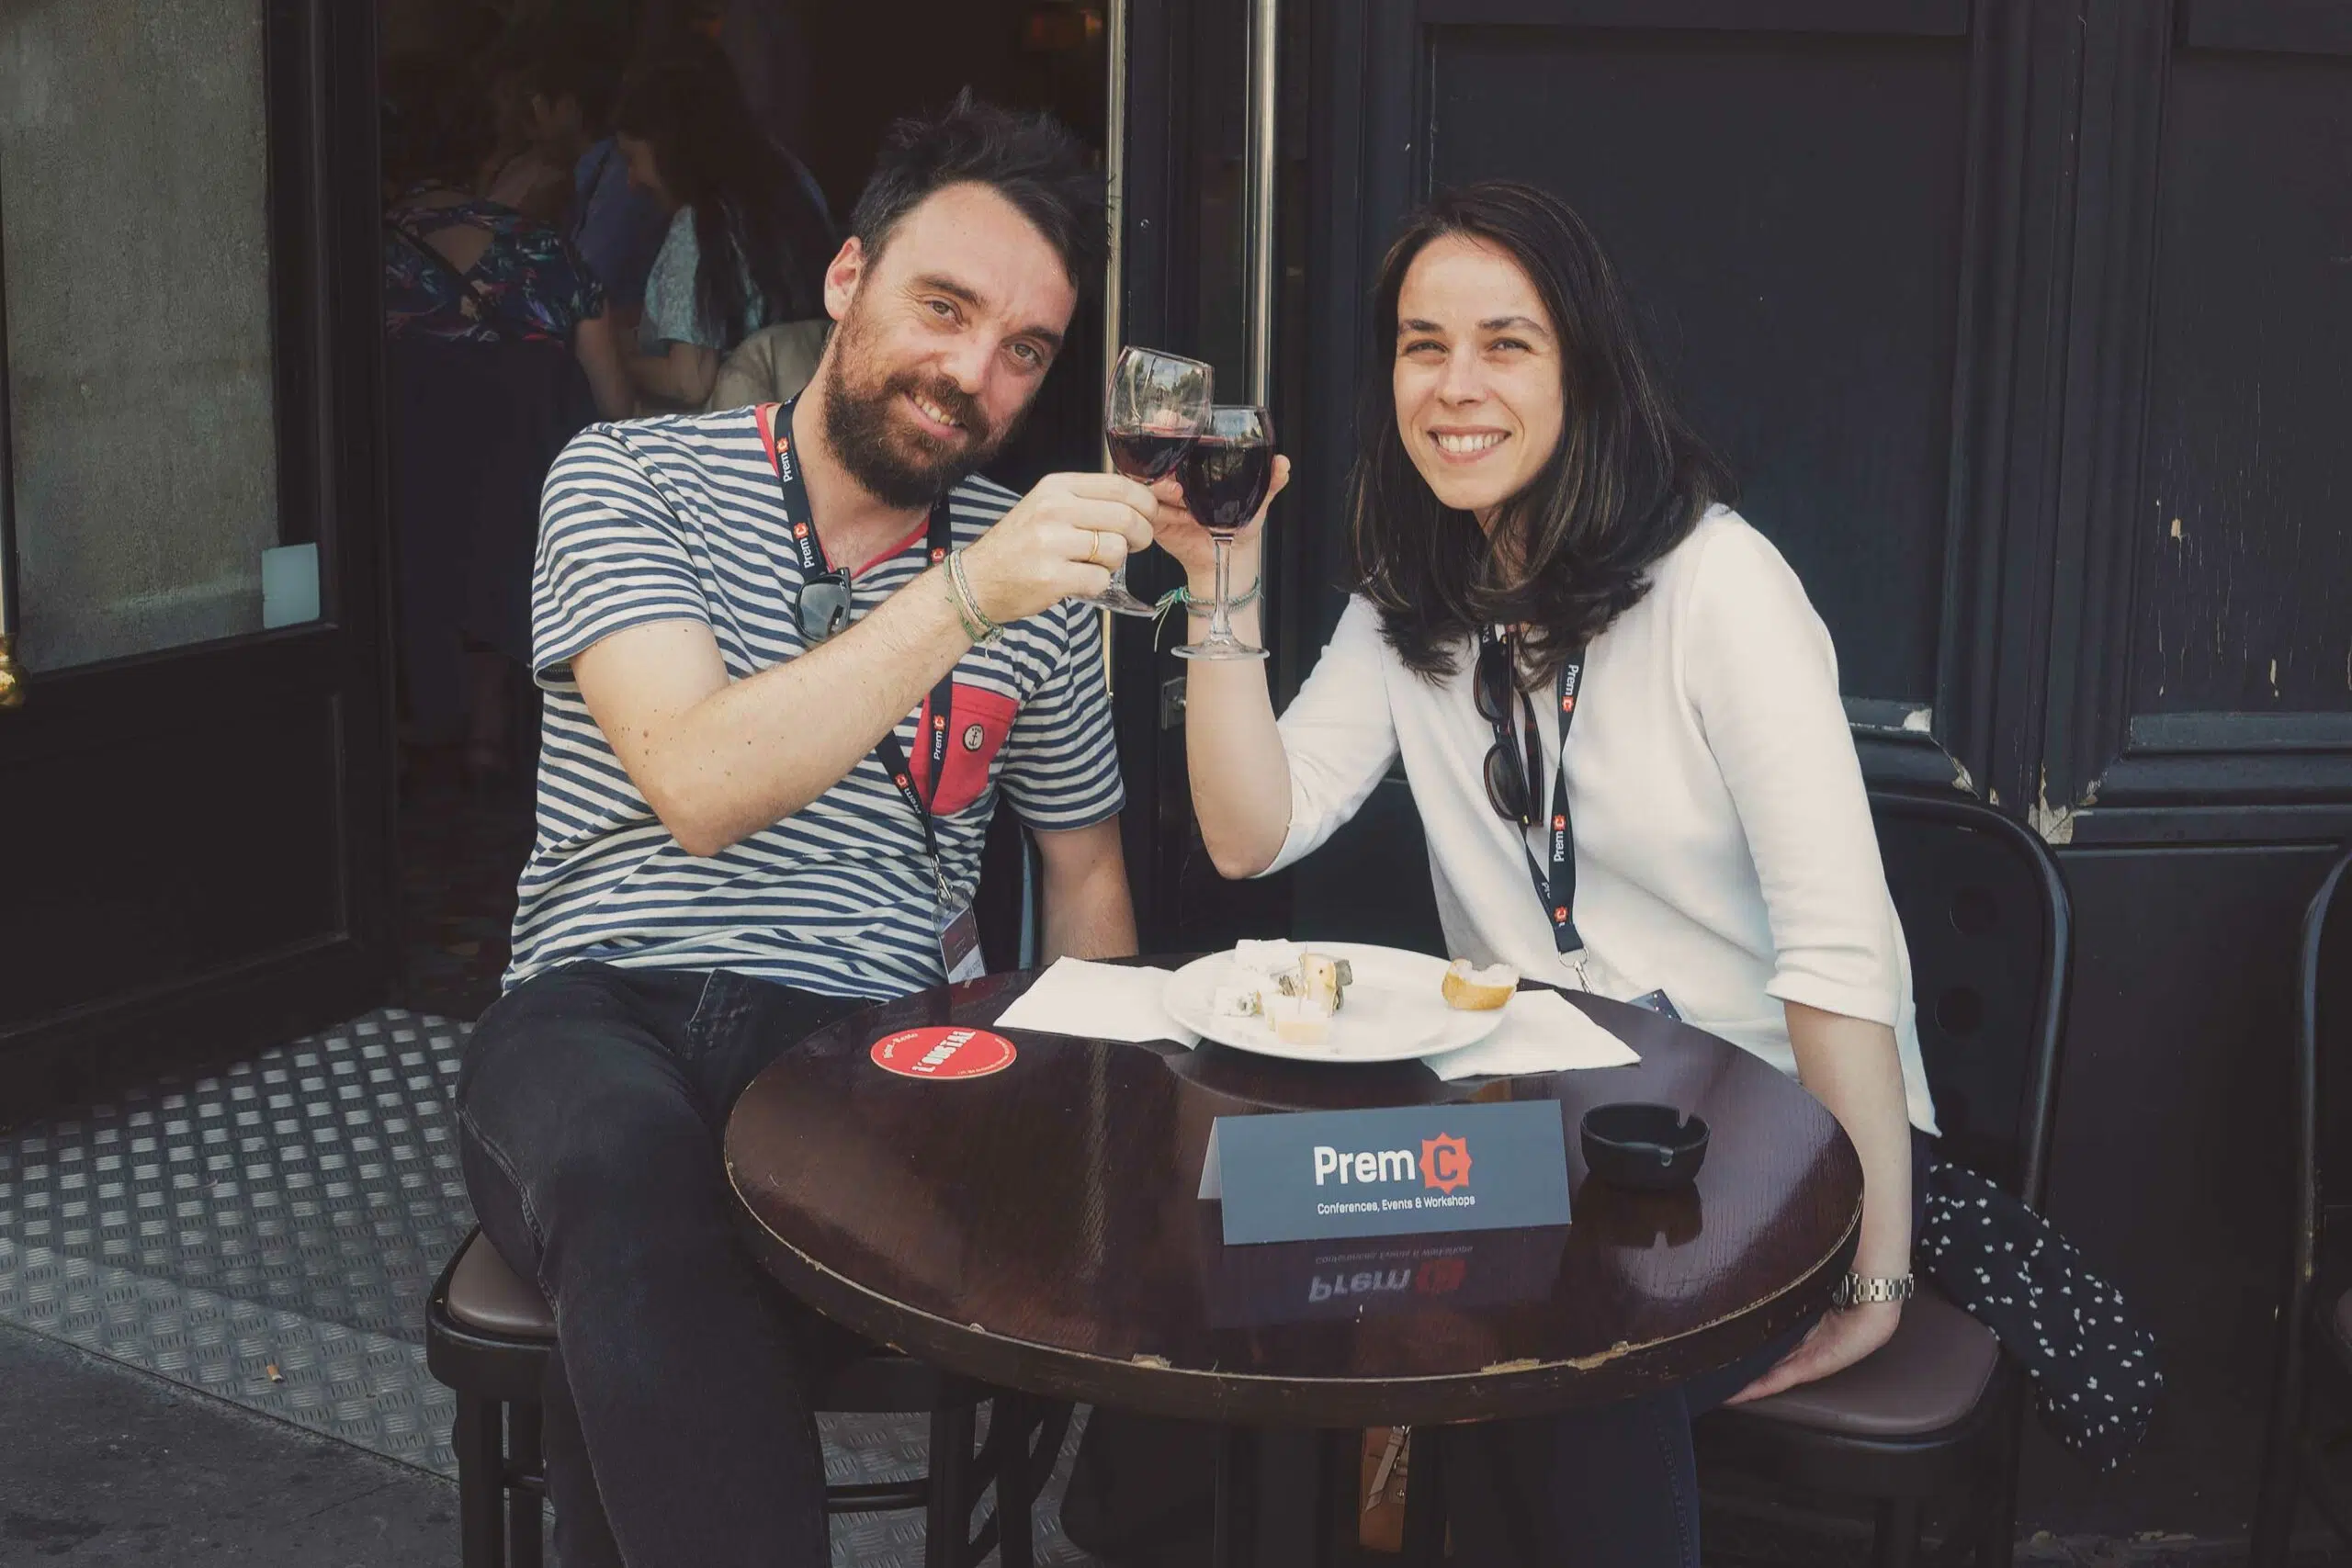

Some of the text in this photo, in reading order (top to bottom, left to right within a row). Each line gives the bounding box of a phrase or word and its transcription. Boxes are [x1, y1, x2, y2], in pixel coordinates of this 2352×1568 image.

[781, 452, 793, 483] Prem
[800, 537, 814, 570] Prem
[1565, 664, 1579, 695] Prem
[933, 730, 943, 761] Prem
[1554, 830, 1565, 863] Prem
[1314, 1146, 1416, 1186] Prem
[1317, 1195, 1476, 1215] Conferences, Events & Workshops
